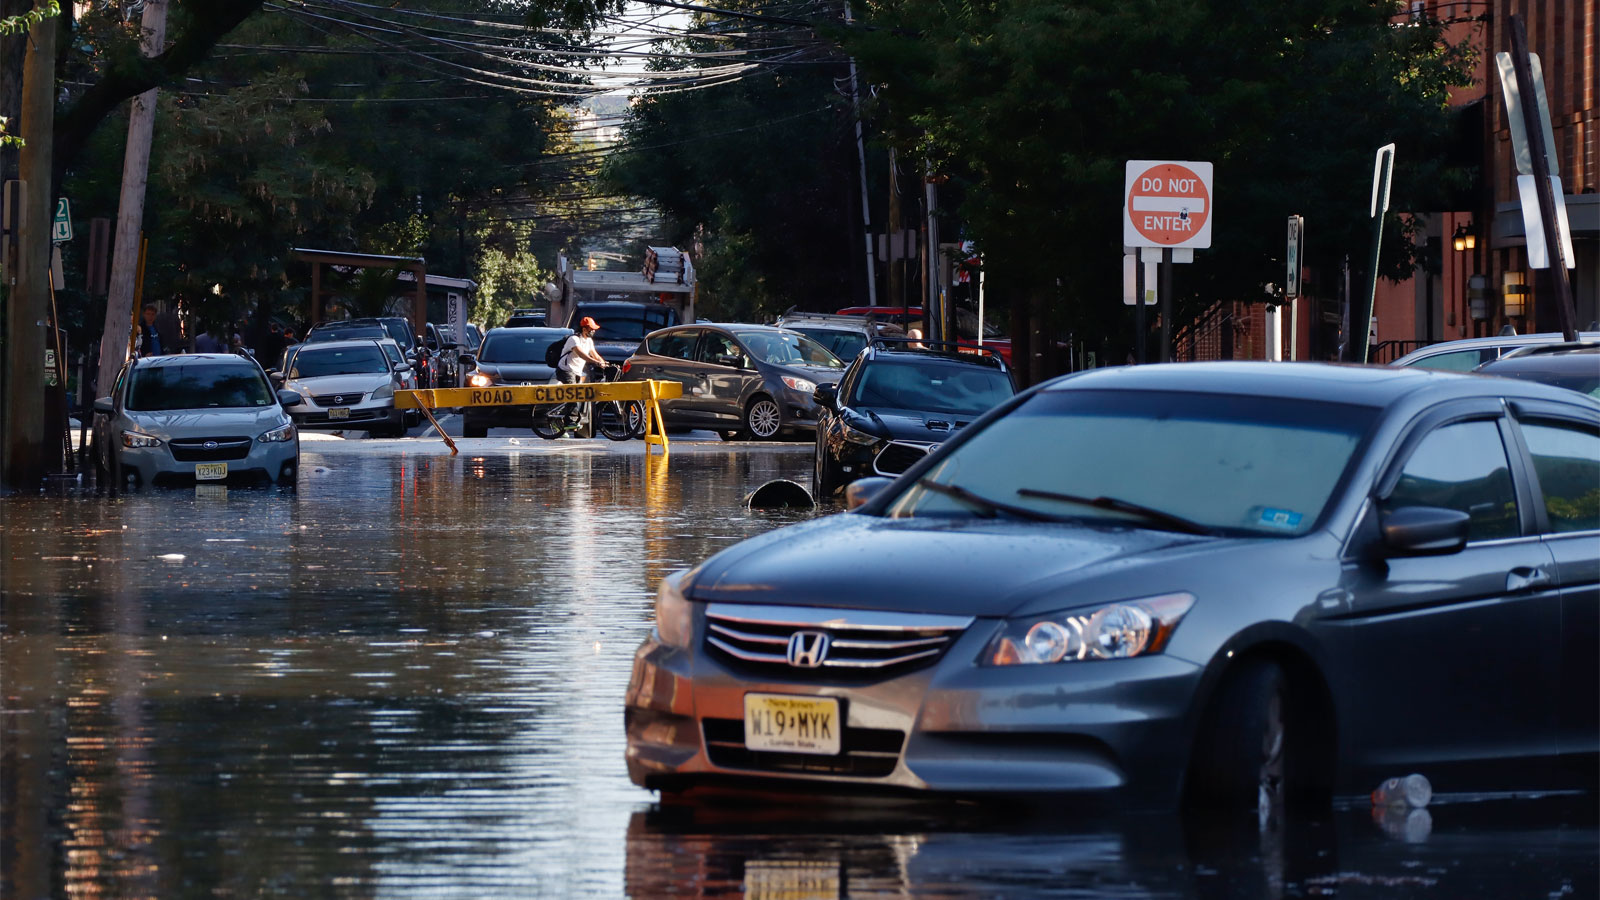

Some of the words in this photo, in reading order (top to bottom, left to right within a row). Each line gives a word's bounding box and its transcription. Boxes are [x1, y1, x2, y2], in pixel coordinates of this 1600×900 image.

[1142, 178, 1162, 192] DO
[1169, 178, 1197, 193] NOT
[56, 201, 66, 217] 2
[1144, 216, 1191, 231] ENTER
[472, 390, 513, 404] ROAD
[535, 386, 595, 401] CLOSED
